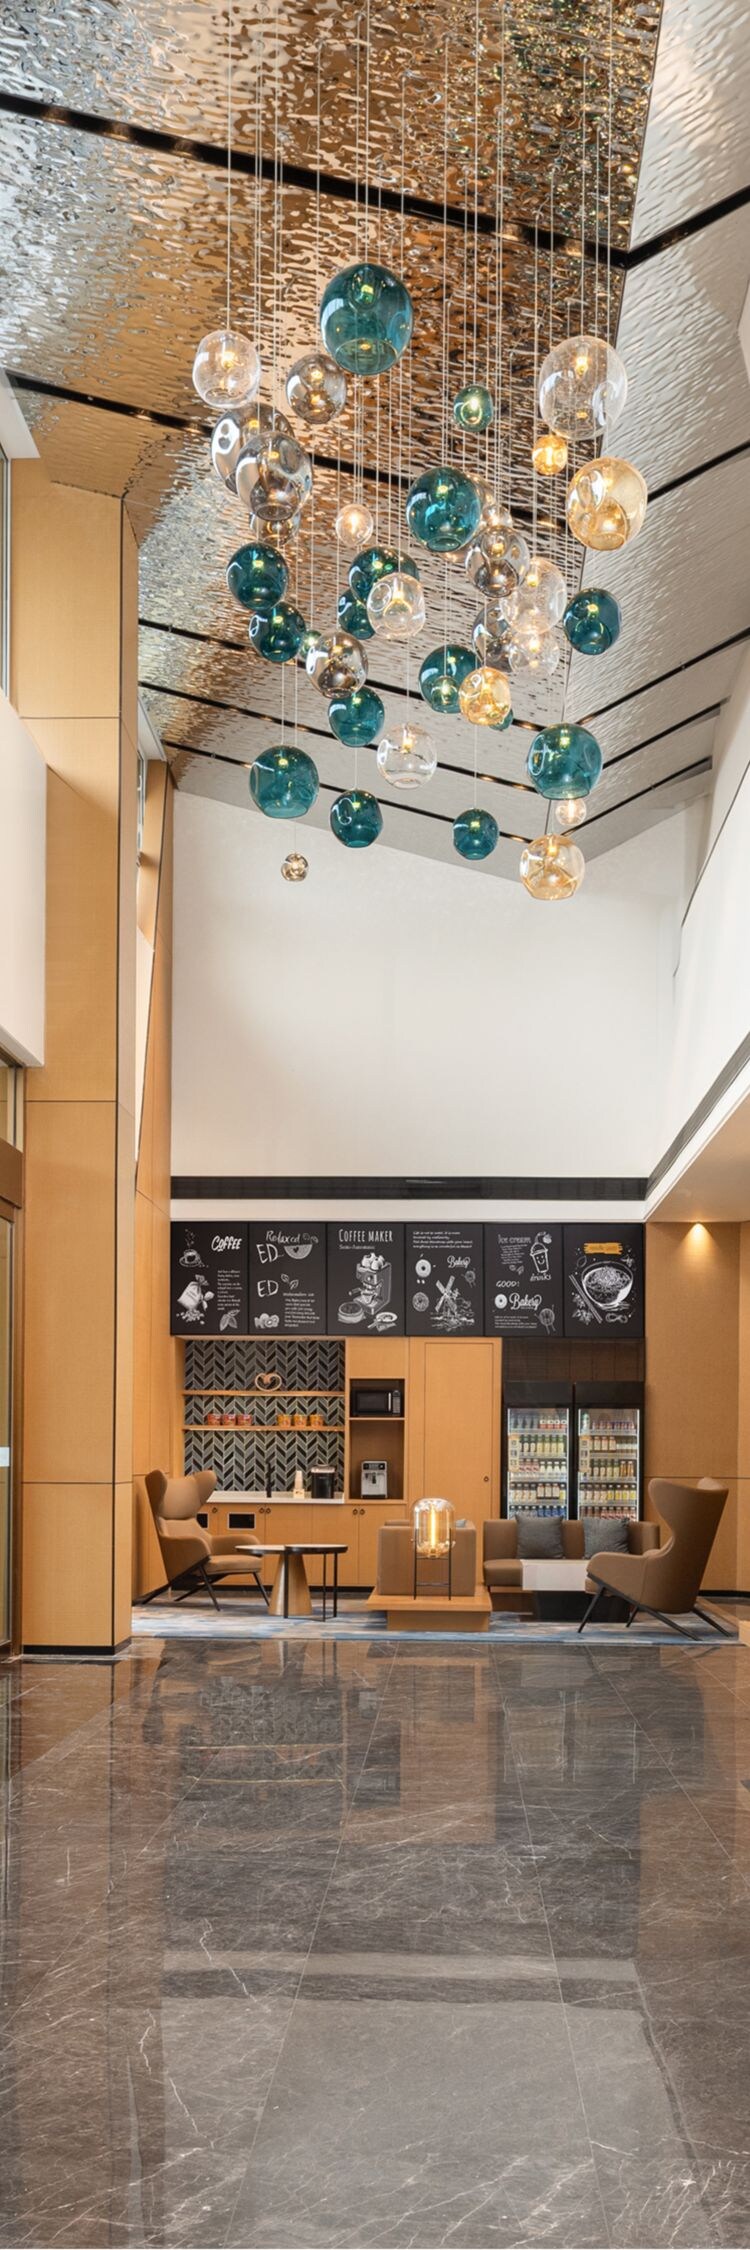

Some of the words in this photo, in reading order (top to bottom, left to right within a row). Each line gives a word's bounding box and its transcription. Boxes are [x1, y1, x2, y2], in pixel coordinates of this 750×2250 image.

[266, 1230, 301, 1244] Relaxed
[338, 1228, 366, 1242] COFFEE
[368, 1230, 393, 1242] MAKER
[256, 1243, 279, 1264] ED
[257, 1280, 279, 1297] ED
[509, 1292, 542, 1311] Bakery
